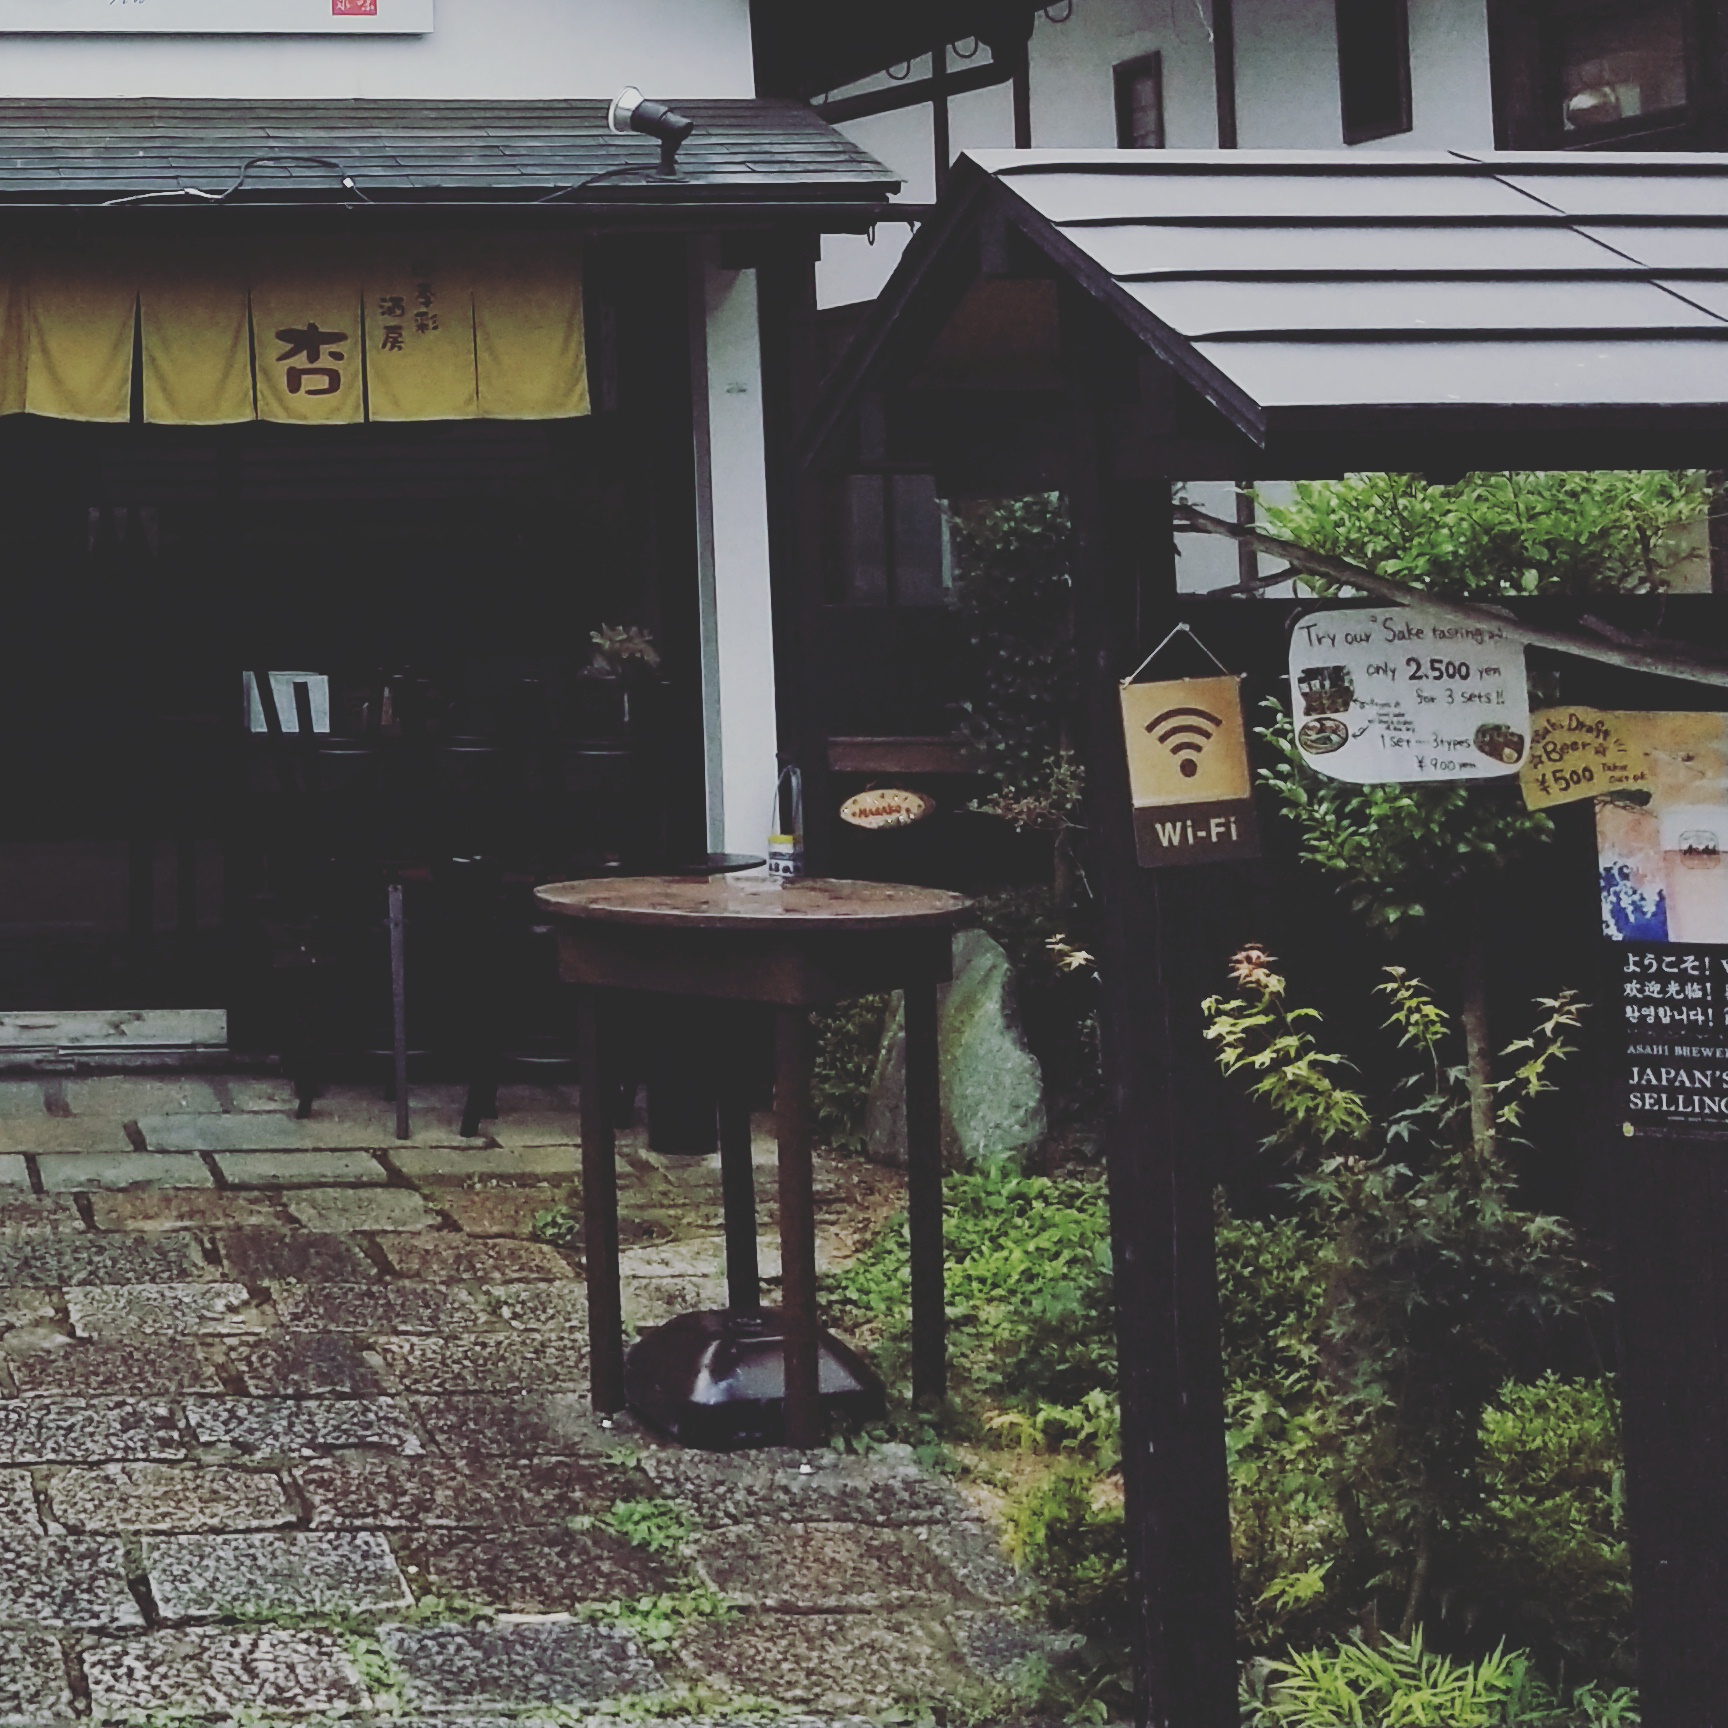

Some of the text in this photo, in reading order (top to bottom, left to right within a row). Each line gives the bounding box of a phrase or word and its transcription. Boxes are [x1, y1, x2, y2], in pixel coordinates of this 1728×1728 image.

[275, 323, 349, 396] 杏
[1298, 623, 1336, 647] Try
[1344, 633, 1372, 645] our
[1366, 662, 1397, 681] only
[1415, 688, 1436, 704] for
[1445, 688, 1455, 705] 3
[1543, 740, 1592, 763] Beer
[1535, 765, 1594, 795] ¥500
[1155, 816, 1238, 847] Wi-Fi
[1674, 1045, 1728, 1059] BREWE
